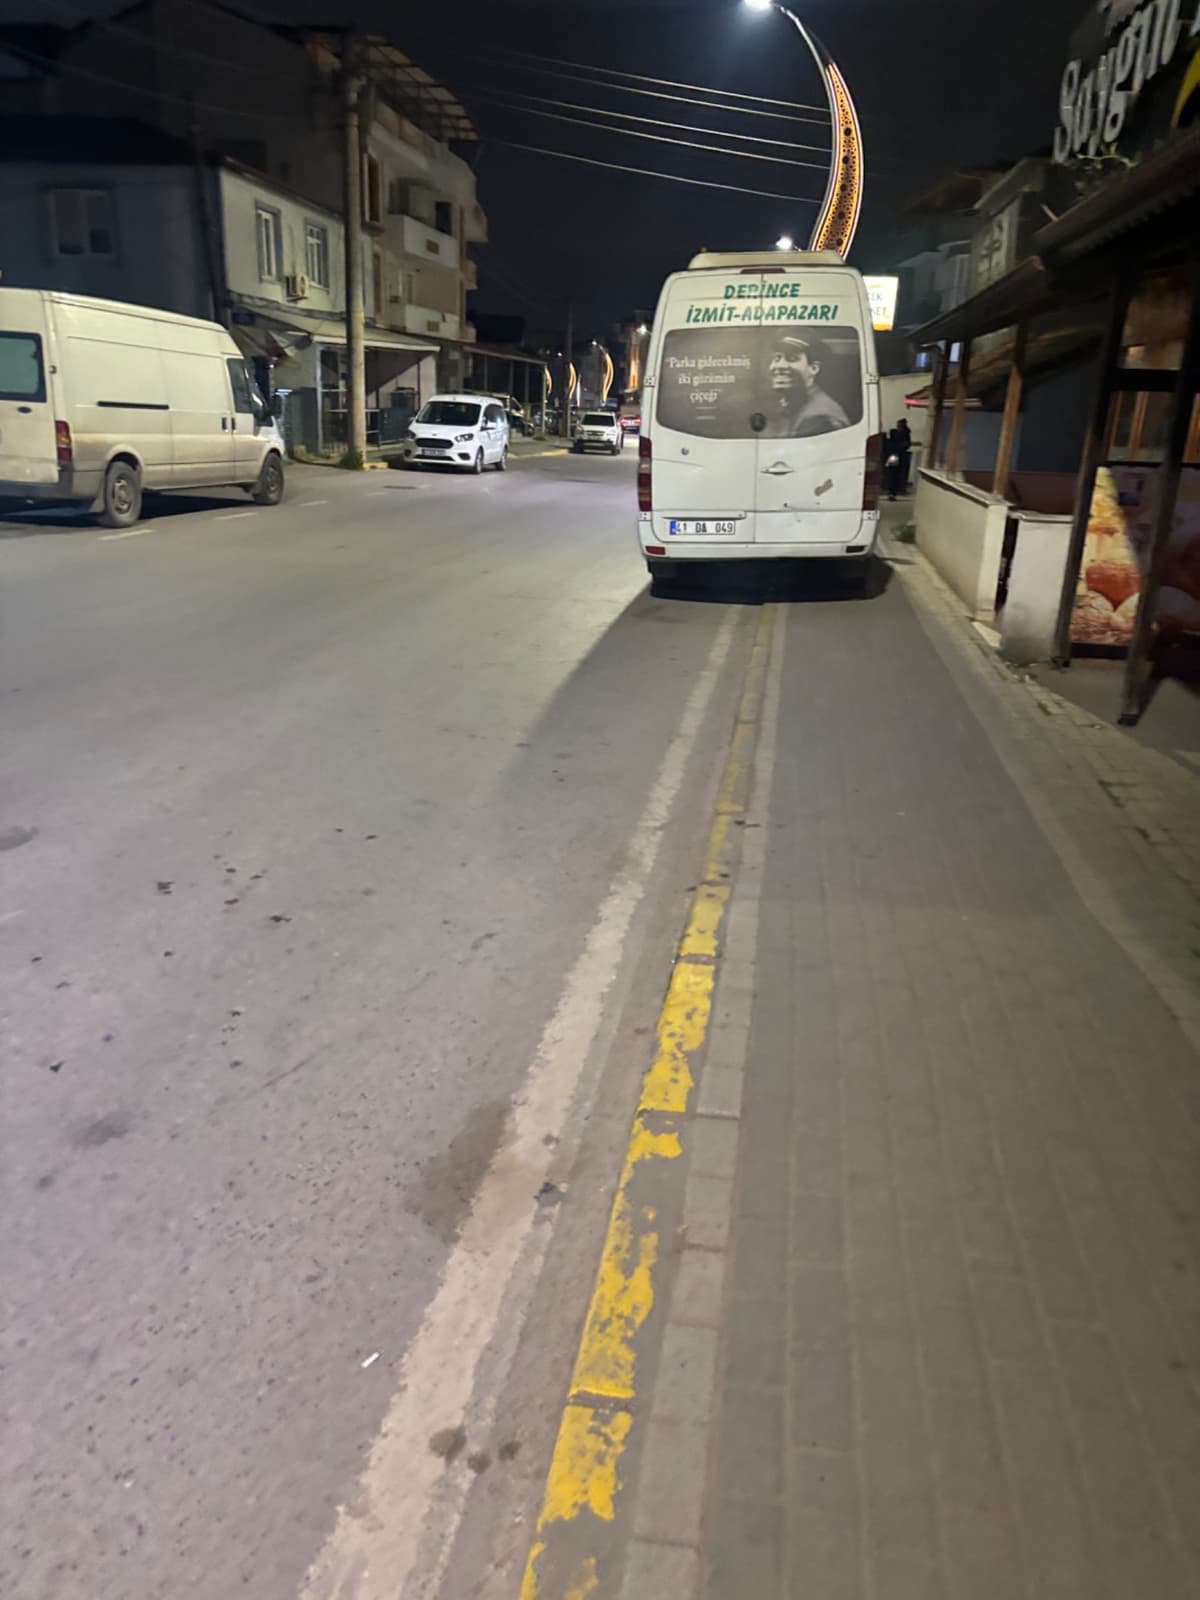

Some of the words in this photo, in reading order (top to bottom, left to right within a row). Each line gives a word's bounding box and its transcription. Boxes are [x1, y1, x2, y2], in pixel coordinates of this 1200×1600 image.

[723, 280, 801, 299] DERİNCE
[686, 304, 839, 323] İZMİT-ADAPAZARI
[676, 523, 687, 533] 41
[695, 523, 707, 533] DA
[715, 523, 734, 533] 049
